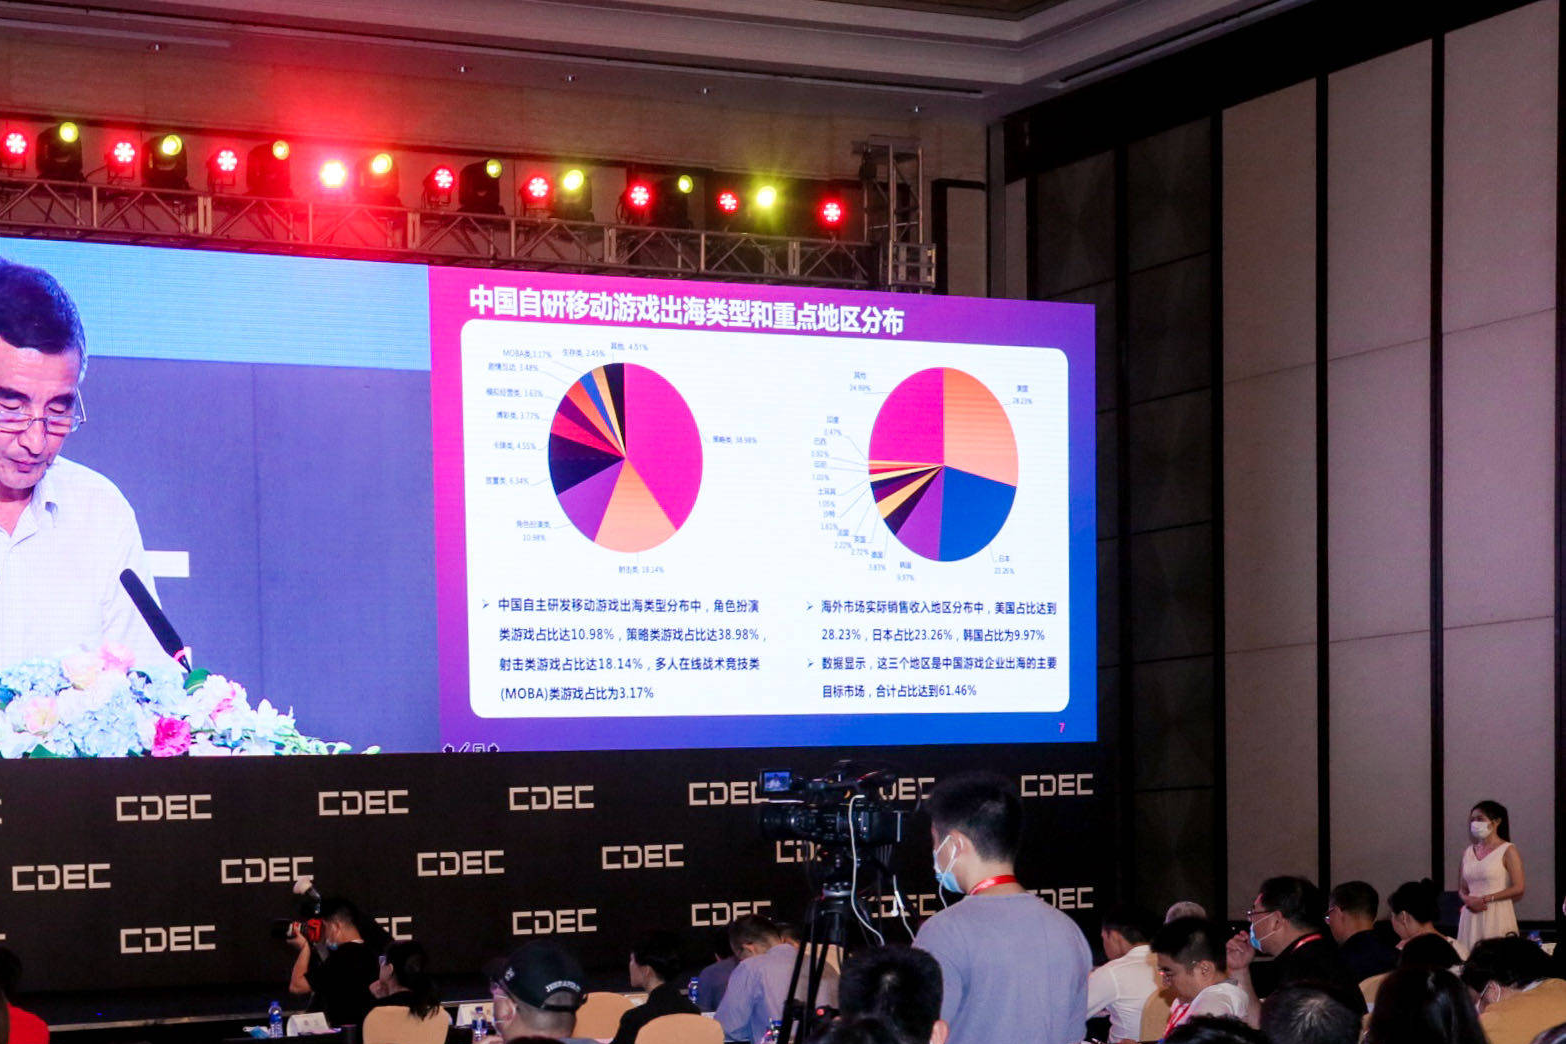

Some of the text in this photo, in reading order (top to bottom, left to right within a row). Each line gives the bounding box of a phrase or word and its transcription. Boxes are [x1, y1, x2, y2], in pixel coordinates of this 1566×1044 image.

[469, 284, 905, 335] 中国自研移动游戏出海类型和重点地区分布
[1058, 721, 1067, 735] 7
[510, 786, 594, 810] CDEC
[1021, 774, 1093, 796] CDEC
[116, 795, 211, 821] CDEC
[319, 790, 408, 815] CDEC
[418, 850, 504, 876] CDEC
[602, 844, 684, 869] CDEC
[12, 864, 110, 891] CDEC
[221, 857, 313, 883] CDEC
[513, 909, 597, 935] CDEC
[121, 925, 215, 953] CDEC
